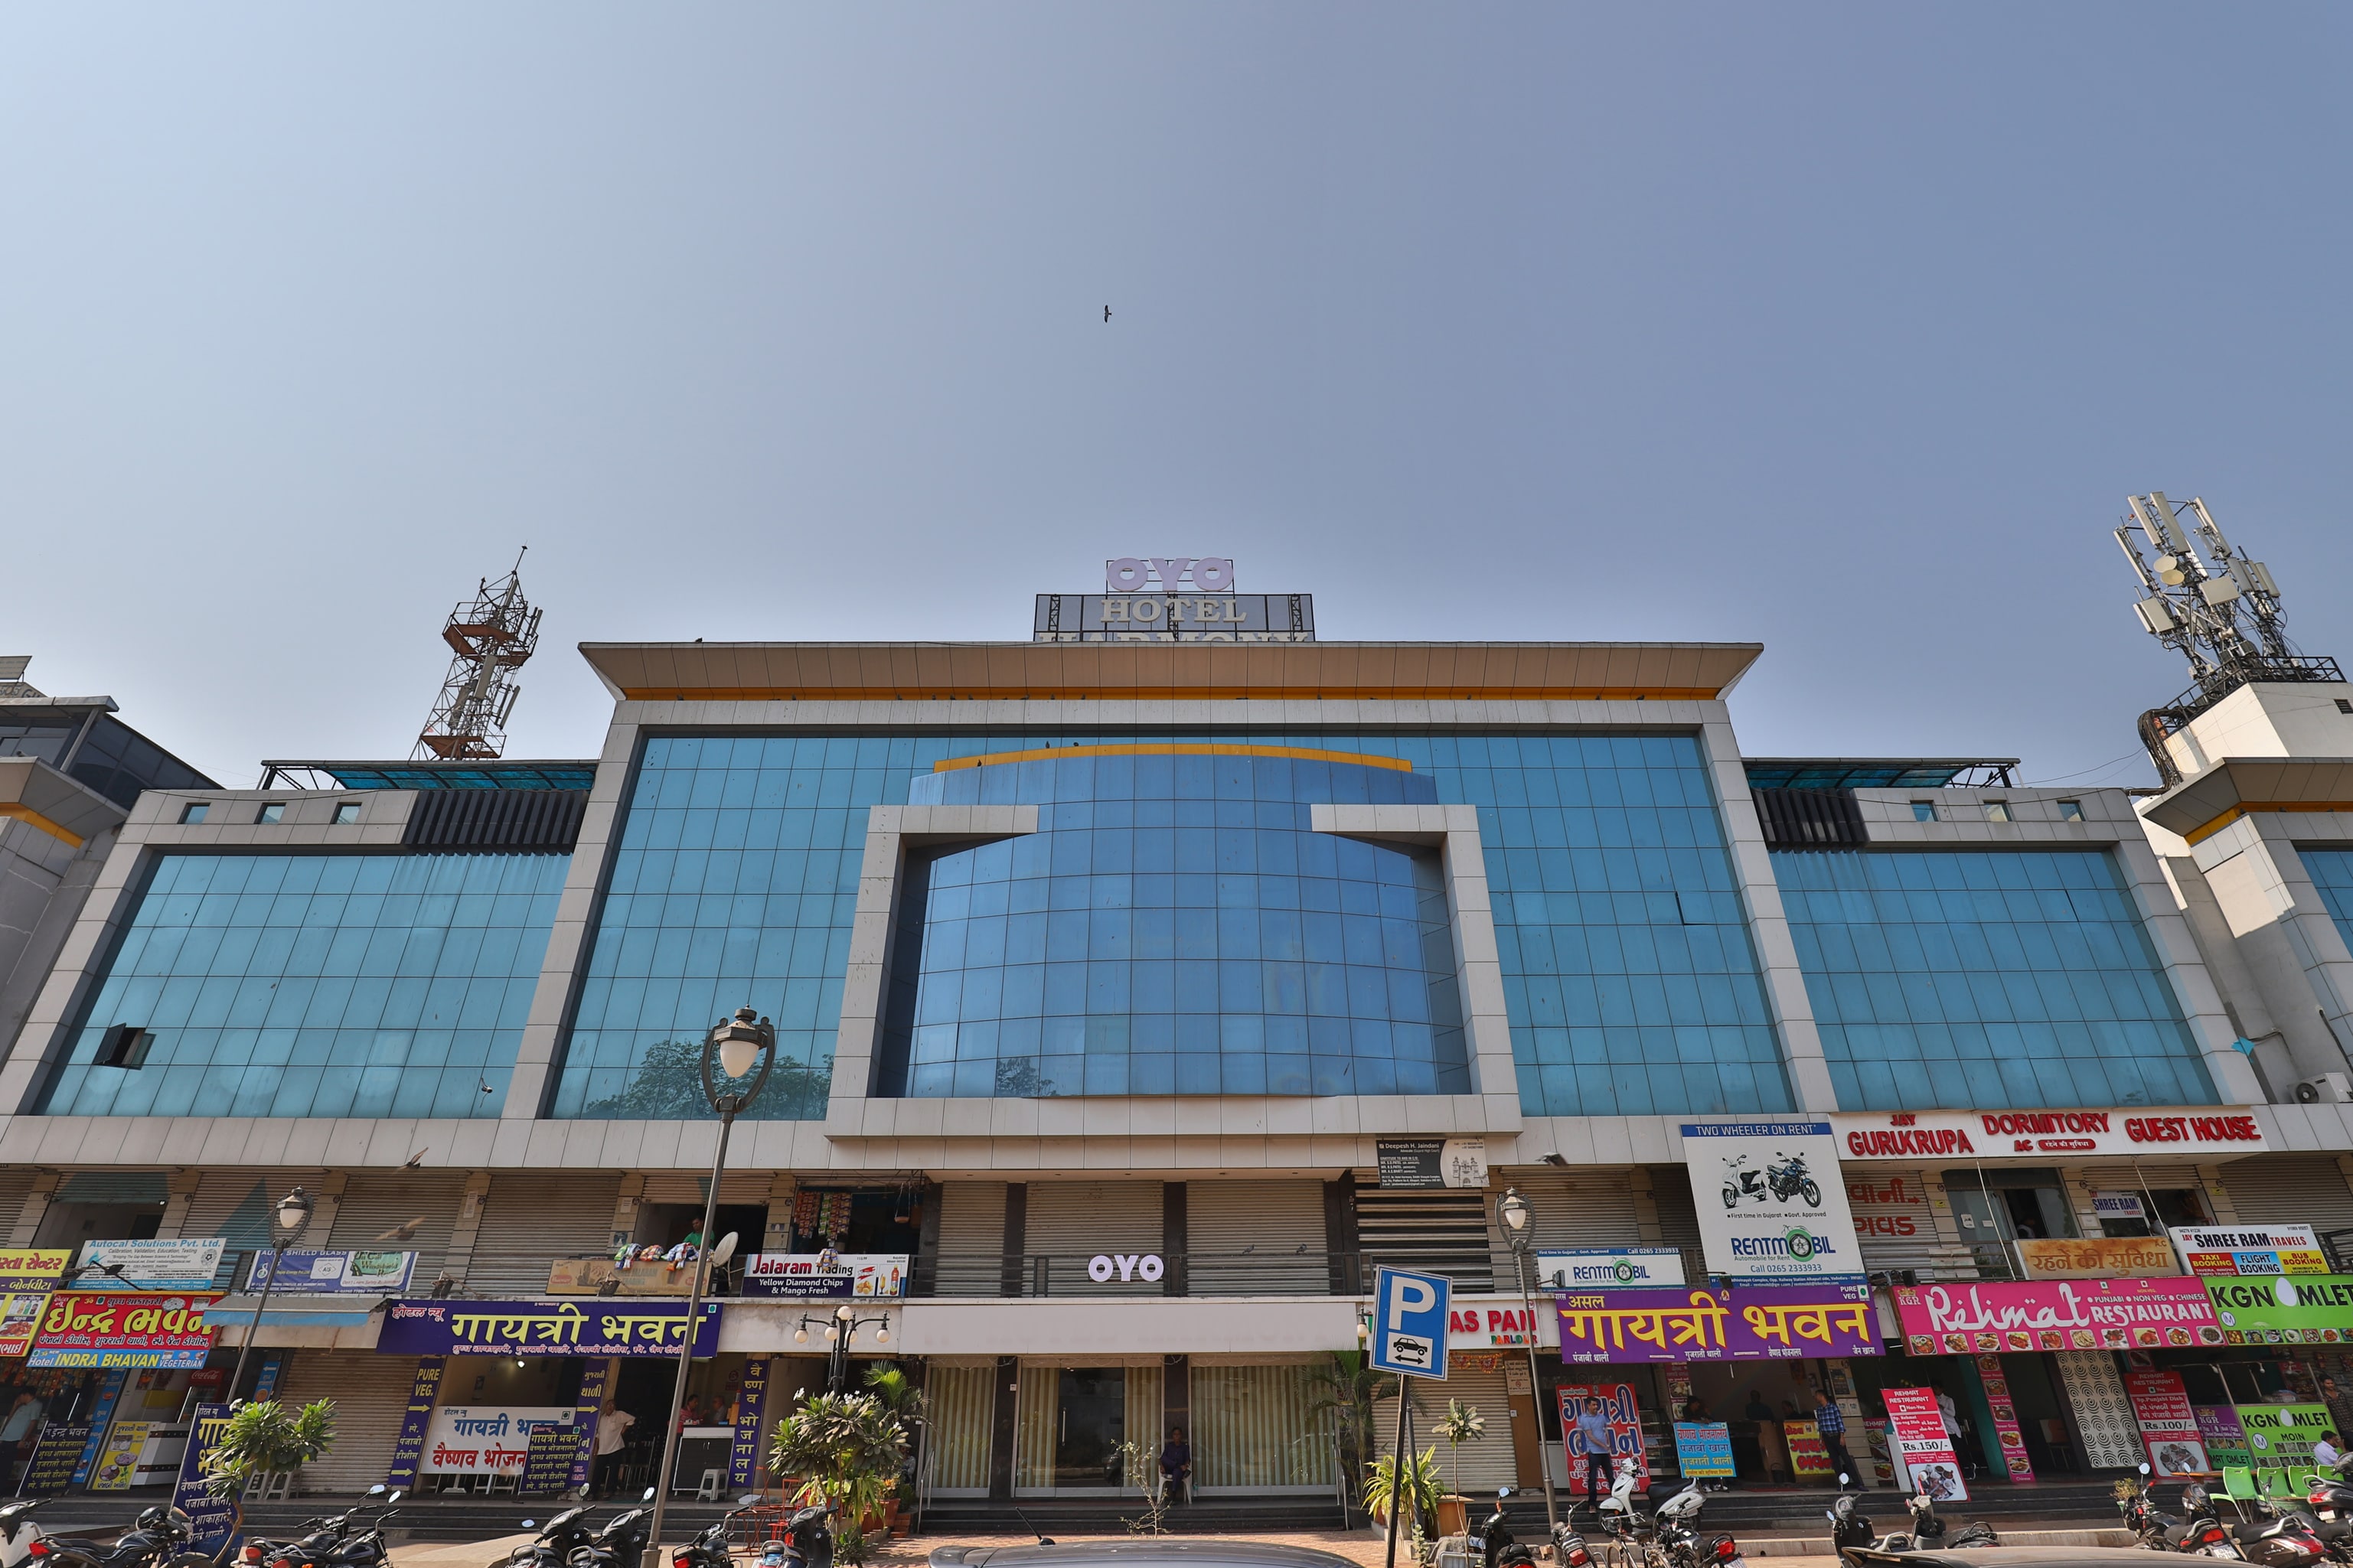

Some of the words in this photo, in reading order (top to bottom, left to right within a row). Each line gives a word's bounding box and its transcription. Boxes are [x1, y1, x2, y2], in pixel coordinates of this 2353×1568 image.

[1107, 557, 1234, 592] OYO
[1100, 598, 1248, 622] HOTEL
[1890, 1114, 1916, 1126] JAY
[1696, 1126, 1718, 1136] TWO
[1722, 1126, 1769, 1136] WHEELER
[1771, 1126, 1786, 1135] ON
[1981, 1113, 2110, 1136] DORMITORY
[2124, 1117, 2190, 1143] GUEST
[2190, 1116, 2262, 1141] HOUSE
[2015, 1139, 2034, 1152] AC
[2092, 1198, 2120, 1211] SHREE
[2121, 1198, 2139, 1210] RAM
[2194, 1234, 2238, 1248] SHREE
[2238, 1233, 2271, 1247] RAM
[2270, 1236, 2307, 1247] TRAVELS
[752, 1254, 812, 1275] Jalaram
[2031, 1249, 2073, 1272] रहने
[2074, 1248, 2104, 1270] की
[2240, 1254, 2271, 1263] FLIGHT
[1088, 1255, 1163, 1282] OYO
[2240, 1263, 2280, 1273] BOOKING
[822, 1279, 844, 1287] Chips
[781, 1287, 807, 1296] Mango
[2210, 1286, 2275, 1308] KGN
[1389, 1275, 1436, 1331] P
[1568, 1296, 1605, 1309] असल
[392, 1304, 427, 1319] होटल
[2090, 1303, 2213, 1326] RESTAURANT
[452, 1302, 589, 1345] गायत्री
[601, 1315, 707, 1345] भवन
[1487, 1309, 1537, 1332] PAN
[1559, 1291, 1732, 1351] गायत्री
[1743, 1303, 1869, 1345] भवन
[28, 1357, 54, 1367] Hotel
[54, 1353, 99, 1367] INDRA
[101, 1354, 160, 1367] BHAVAN
[159, 1359, 203, 1368] VEGETERIAN
[417, 1369, 440, 1381] PURE
[415, 1384, 433, 1396] VEG.
[454, 1413, 510, 1437] गायत्री
[2144, 1421, 2192, 1430] Rs.100/-
[2242, 1414, 2280, 1428] KGN
[69, 1428, 89, 1437] भवन
[531, 1429, 557, 1442] गायत्री
[559, 1434, 579, 1442] भवन
[400, 1436, 423, 1446] पंजाबी
[1902, 1441, 1948, 1451] Rs.150/-
[432, 1442, 478, 1469] वैष्णव
